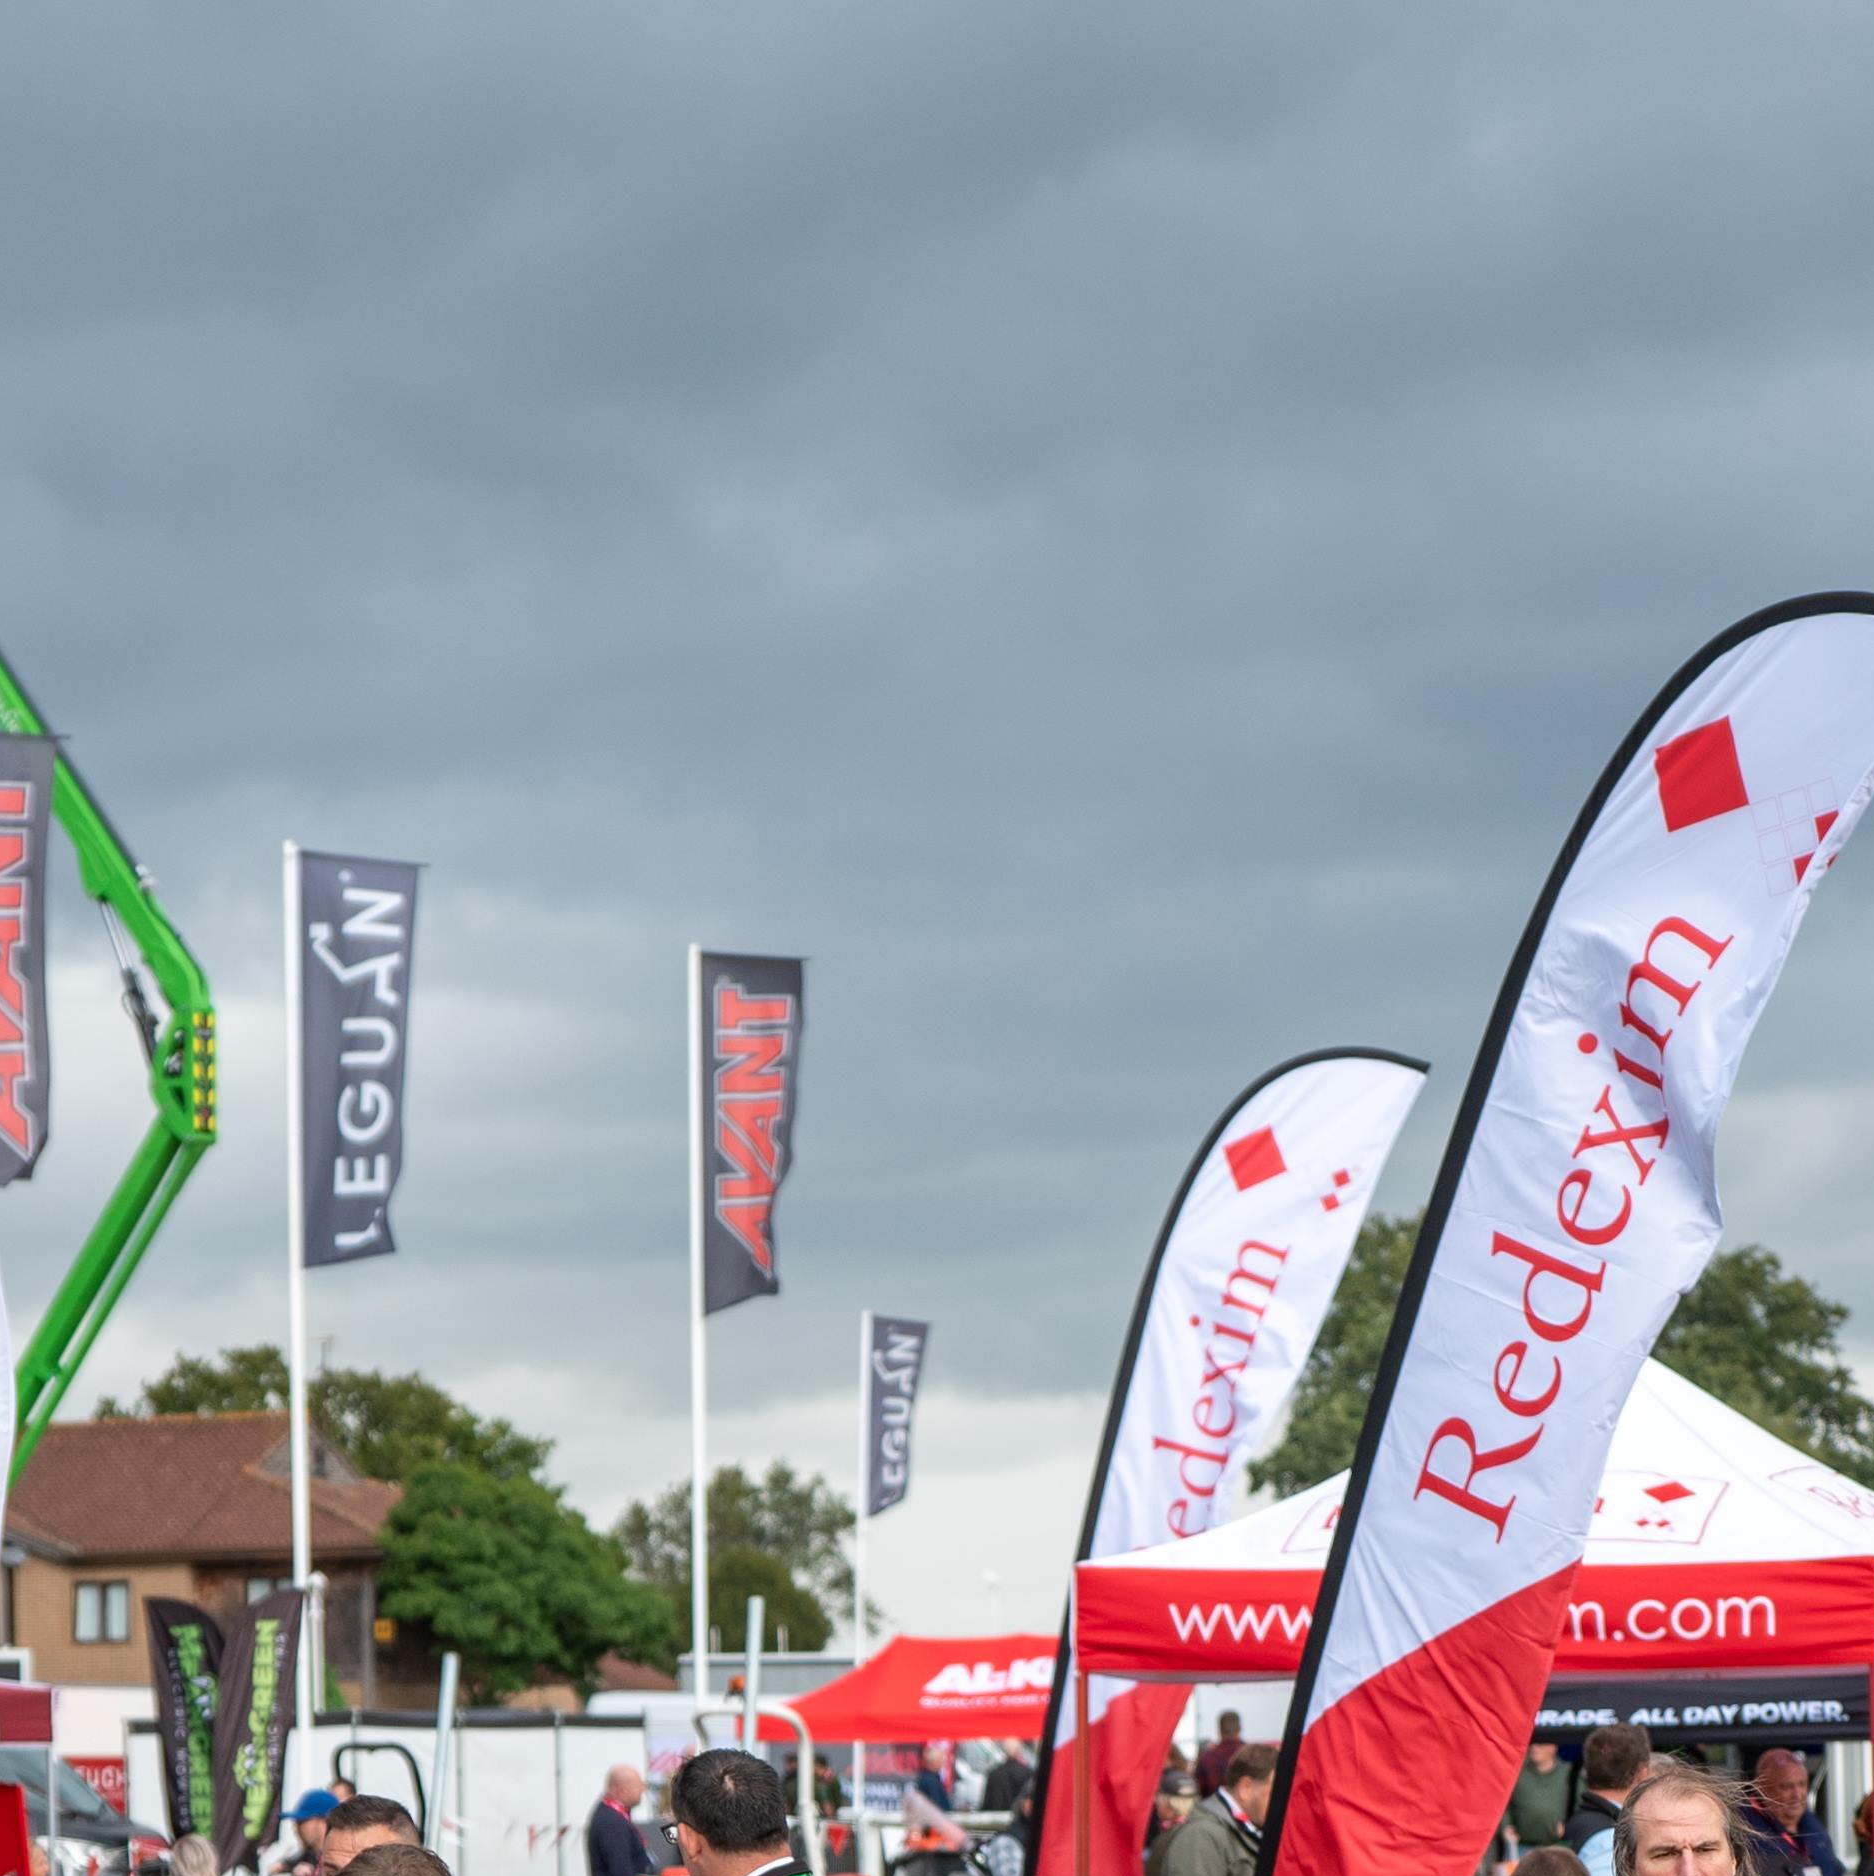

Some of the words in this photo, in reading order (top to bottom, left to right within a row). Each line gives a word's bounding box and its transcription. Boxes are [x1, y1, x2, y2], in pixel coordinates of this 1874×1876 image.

[1413, 915, 1735, 1545] Redexim
[1152, 1237, 1292, 1540] edexim
[1536, 1708, 1618, 1728] RADE.
[1630, 1707, 1678, 1727] ALL
[1682, 1705, 1737, 1726] DAY
[1743, 1700, 1850, 1724] POWER.
